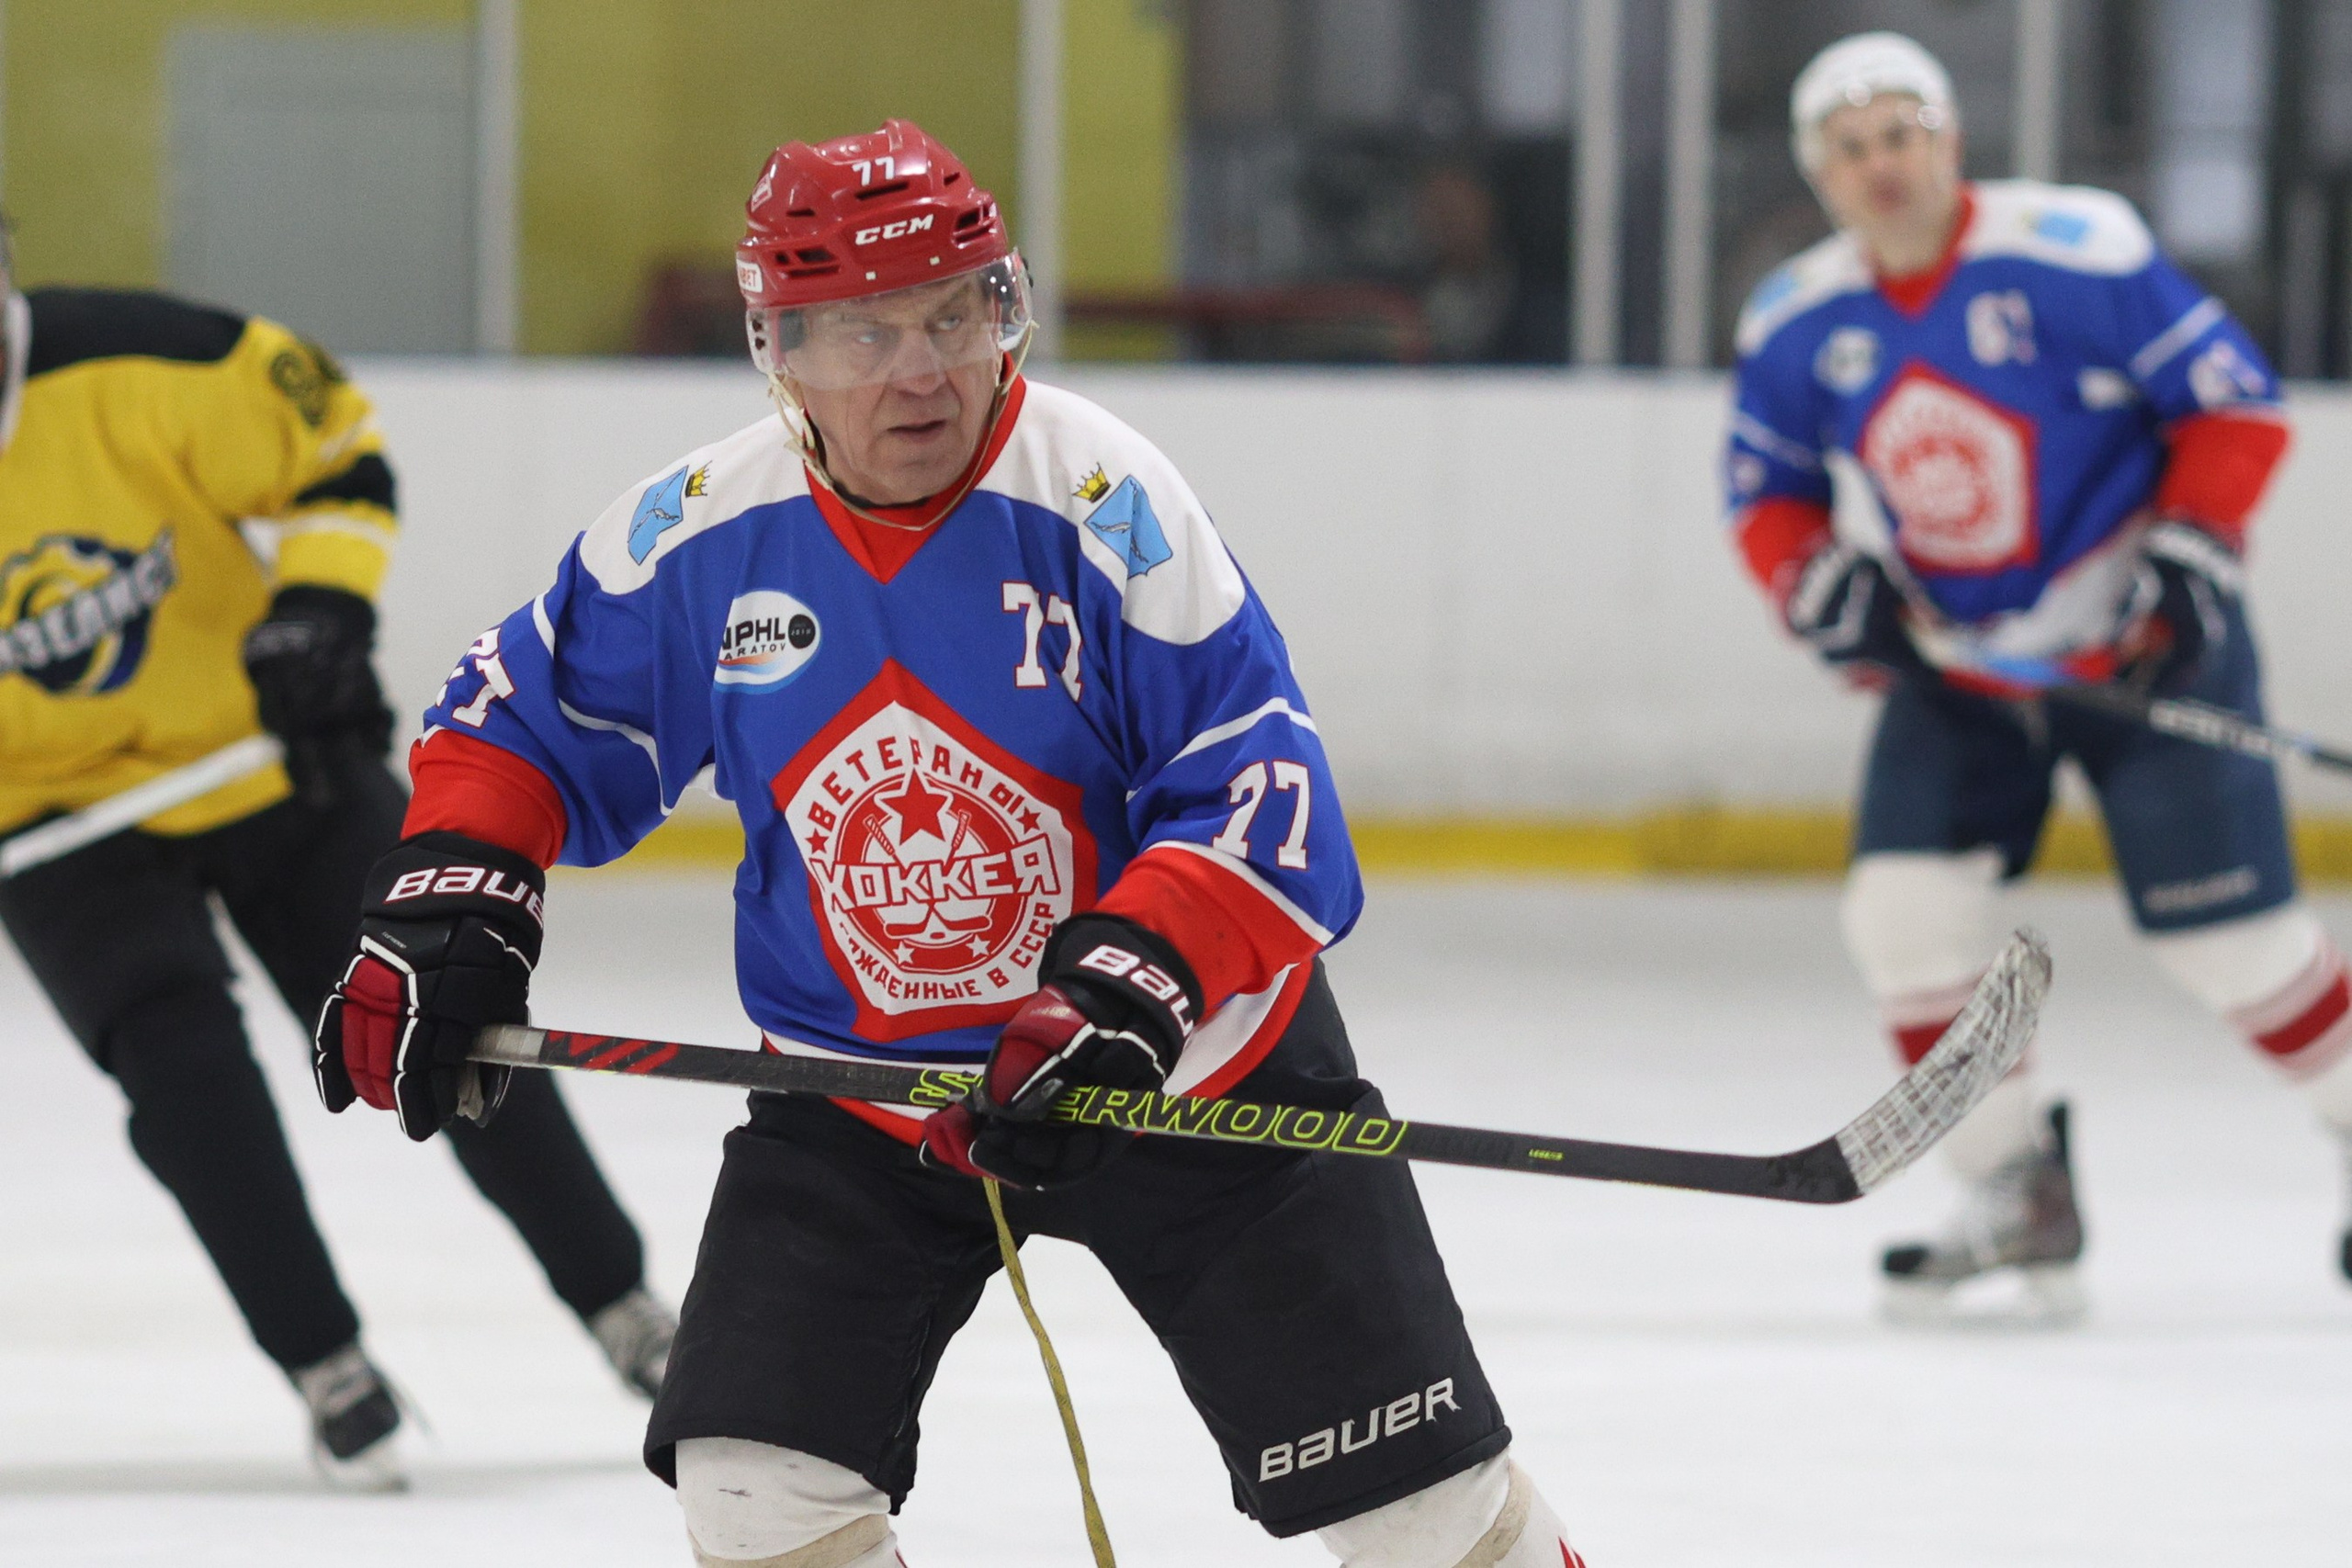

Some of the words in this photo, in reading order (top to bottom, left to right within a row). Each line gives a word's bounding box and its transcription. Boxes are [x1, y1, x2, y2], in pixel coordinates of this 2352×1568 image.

[852, 155, 895, 186] 77
[854, 213, 934, 246] CCM
[723, 643, 786, 660] ARATOV
[1001, 581, 1083, 704] 77
[807, 736, 1025, 832] ВЕТЕРАНЫ
[1212, 758, 1310, 870] 77
[809, 834, 1061, 913] ХОККЕЯ
[839, 921, 982, 999] ЖДЕННЫЕ
[986, 967, 1010, 989] В
[1009, 902, 1056, 969] СССР
